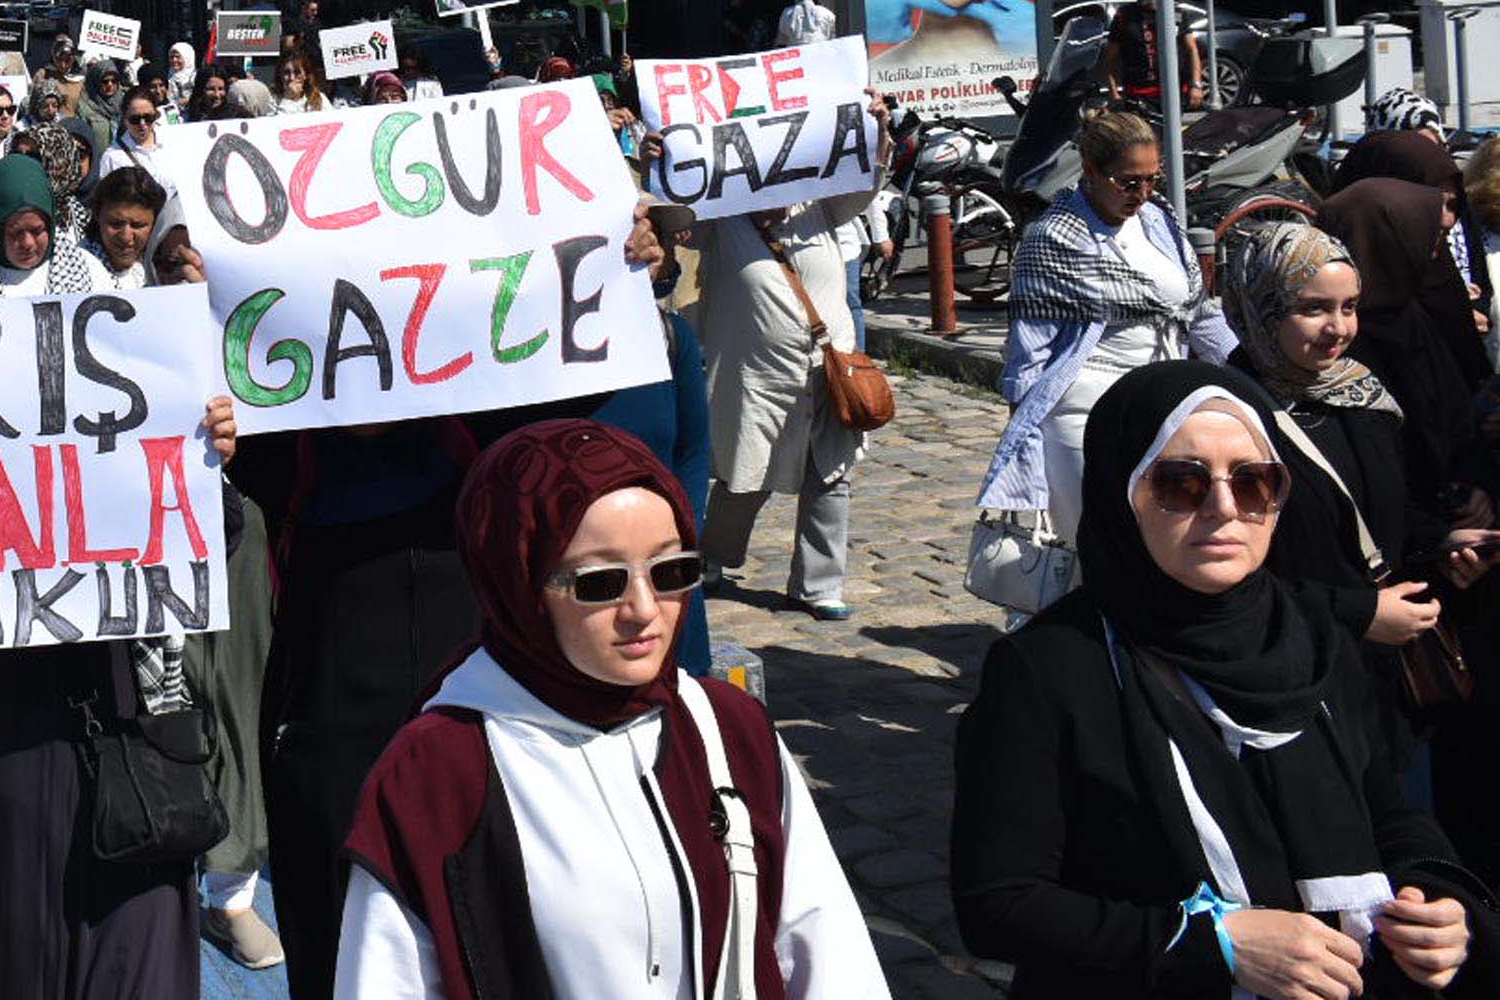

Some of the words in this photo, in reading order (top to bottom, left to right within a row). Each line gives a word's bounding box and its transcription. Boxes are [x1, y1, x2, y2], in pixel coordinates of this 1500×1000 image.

[88, 20, 116, 35] FREE
[333, 44, 368, 58] FREE
[653, 48, 808, 127] FREE
[876, 66, 922, 84] Medikal
[925, 64, 960, 79] Estetik
[202, 90, 597, 245] ÖZGÜR
[658, 102, 871, 204] GAZA
[223, 235, 609, 408] GAZZE
